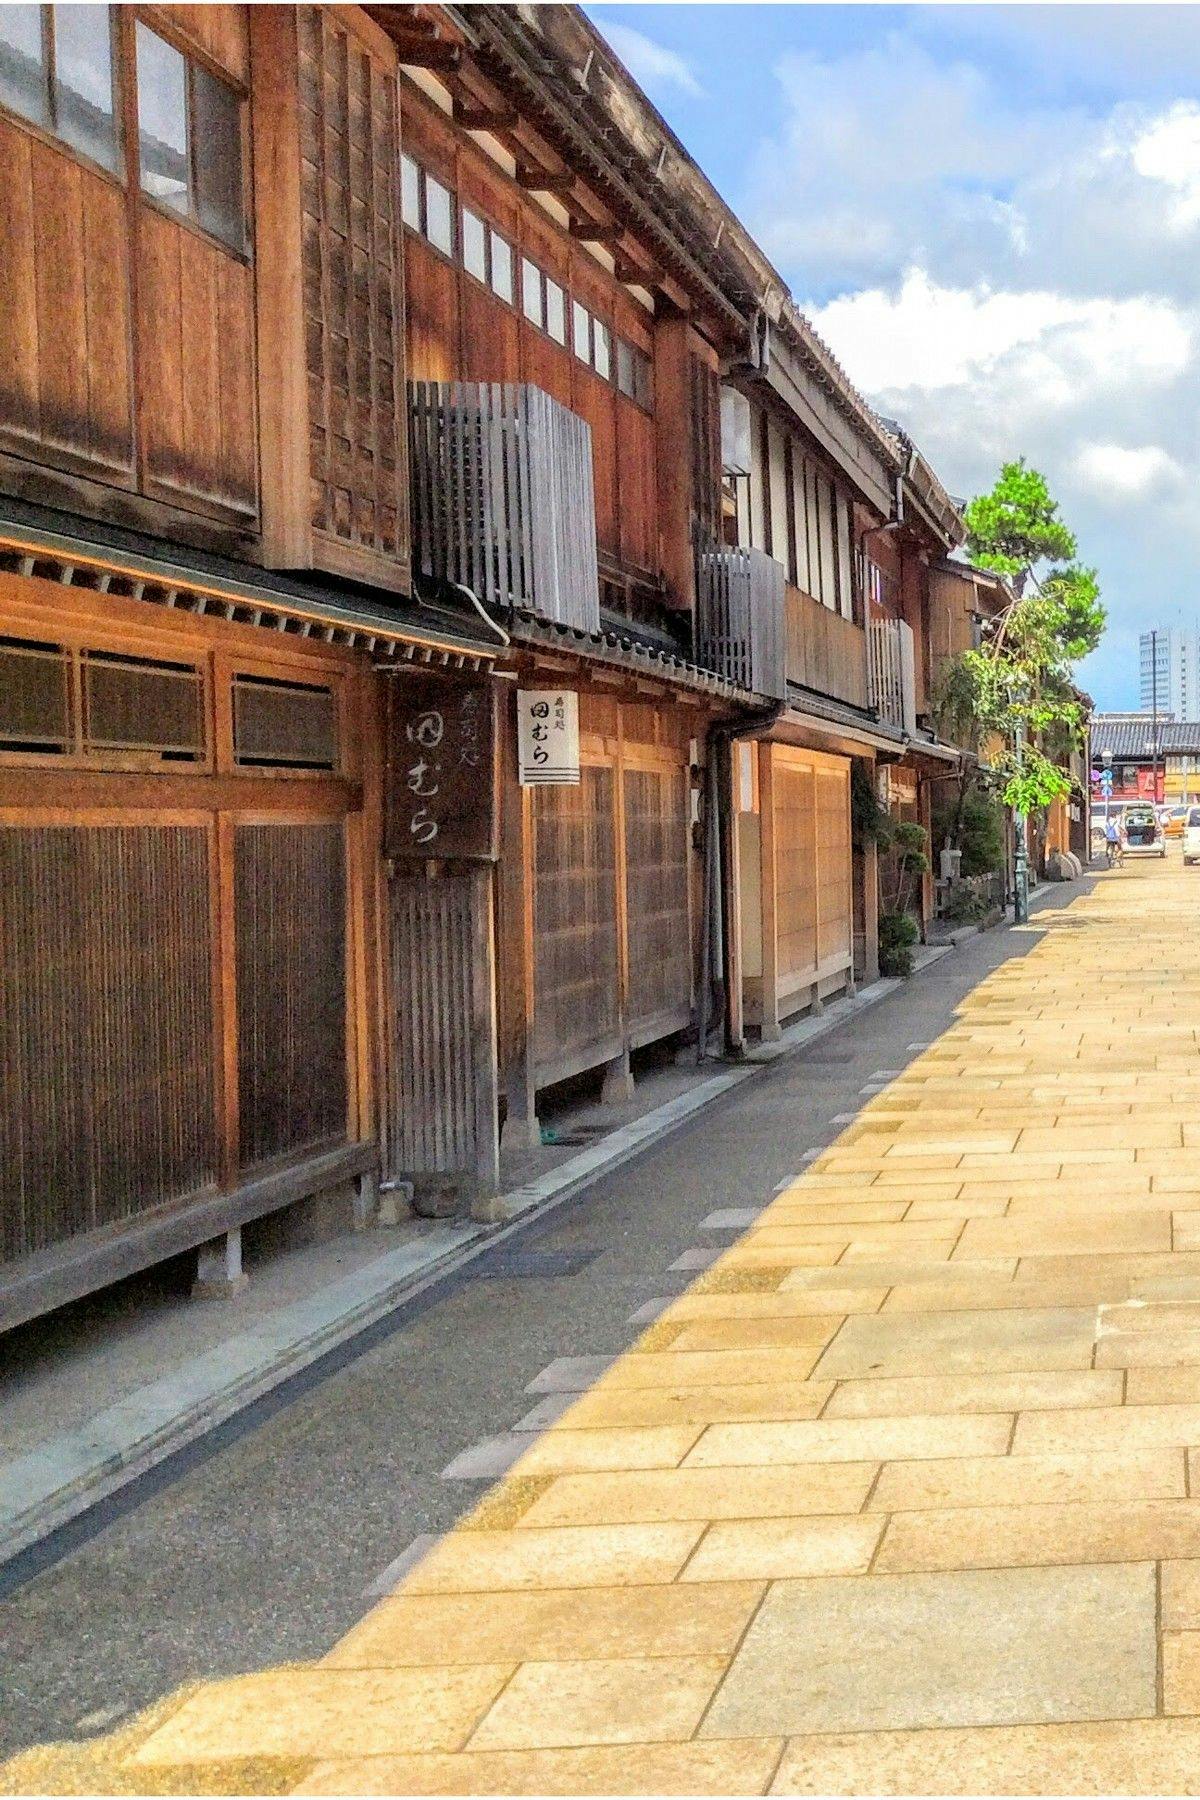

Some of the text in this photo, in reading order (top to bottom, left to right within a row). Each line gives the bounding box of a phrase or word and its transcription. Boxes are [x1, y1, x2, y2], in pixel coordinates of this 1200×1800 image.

[406, 711, 444, 842] 田むら
[530, 701, 549, 764] 田むら
